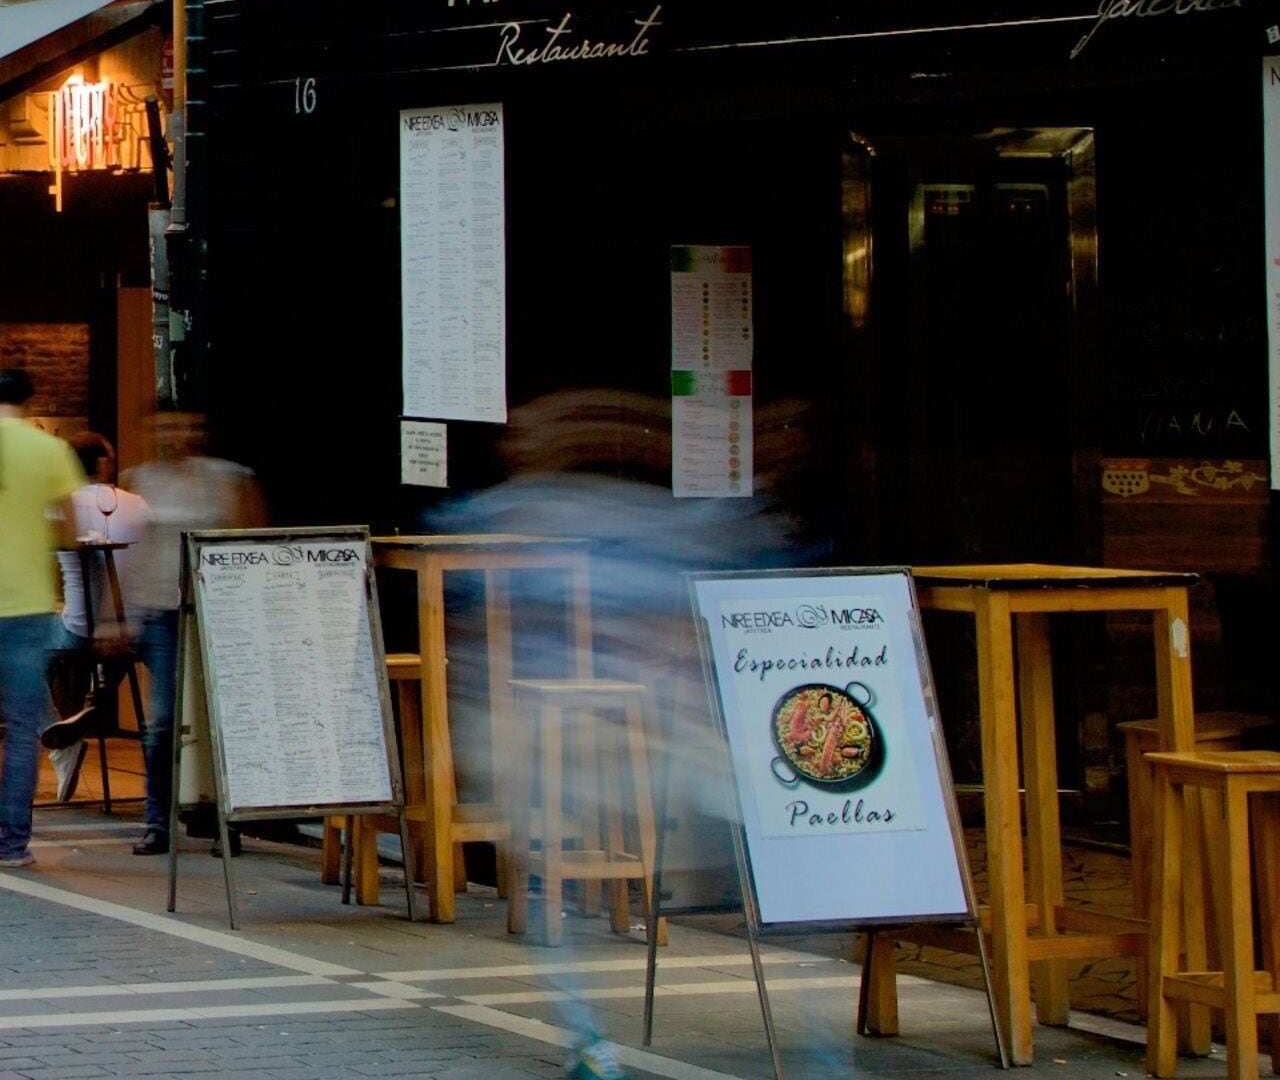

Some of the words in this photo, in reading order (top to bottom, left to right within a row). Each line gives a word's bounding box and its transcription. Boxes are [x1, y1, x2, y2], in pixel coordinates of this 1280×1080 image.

[494, 4, 663, 67] Restaurante
[294, 76, 318, 115] 16
[201, 552, 230, 567] NIRE
[231, 552, 269, 566] ETXEA
[721, 612, 753, 629] NIRE
[754, 611, 794, 627] ETXEA
[733, 645, 889, 681] Especialidad
[785, 797, 896, 827] Paellas
